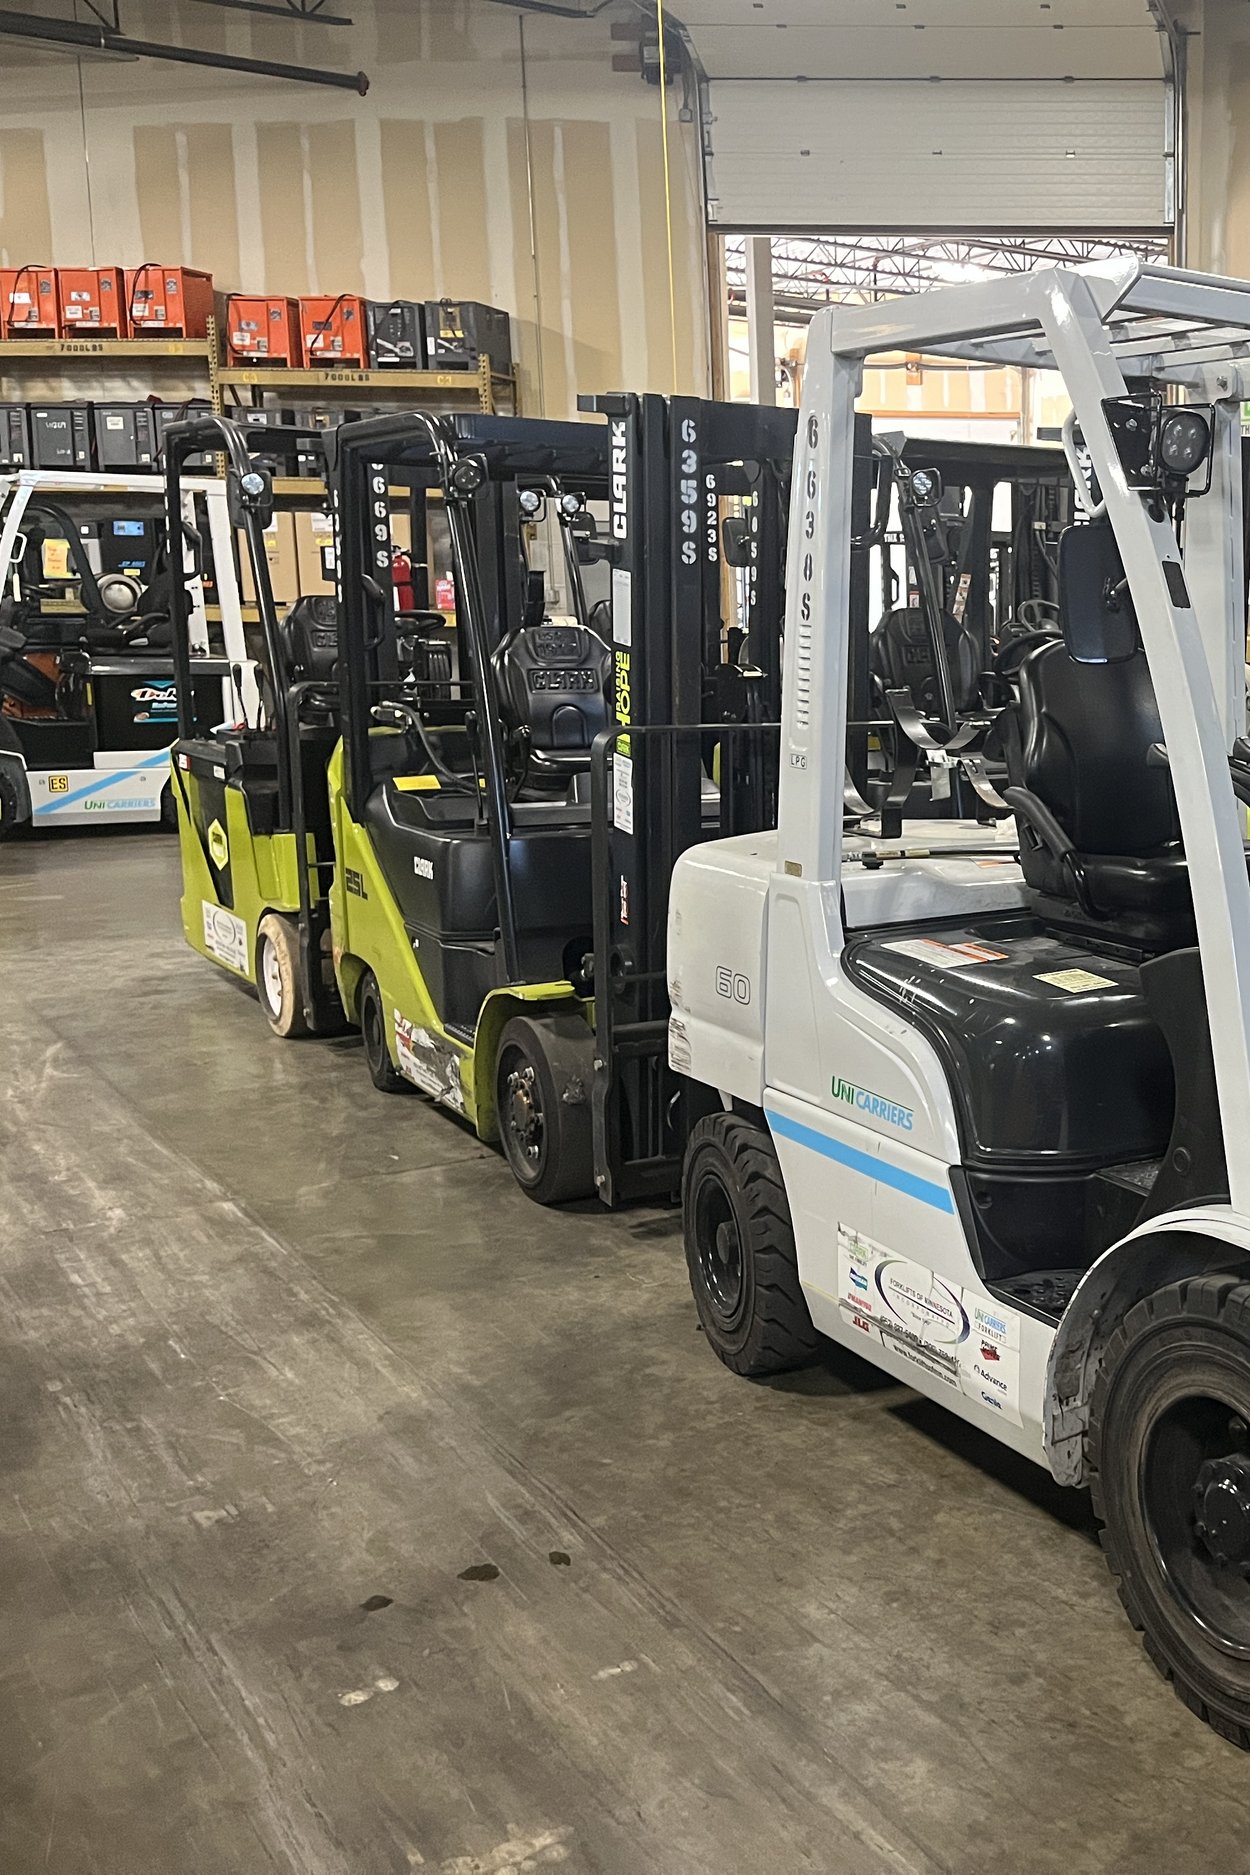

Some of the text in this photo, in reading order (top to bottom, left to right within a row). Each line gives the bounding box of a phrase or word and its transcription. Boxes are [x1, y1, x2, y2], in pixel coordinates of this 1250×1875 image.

[612, 421, 627, 539] CLARK
[680, 419, 698, 565] 6359S
[705, 474, 718, 562] 6923S
[791, 756, 805, 768] LPG
[51, 778, 67, 790] ES
[346, 867, 368, 900] 25L
[716, 965, 751, 1005] 60
[890, 1277, 916, 1298] FORKLIFTS
[980, 1369, 1008, 1392] Advance
